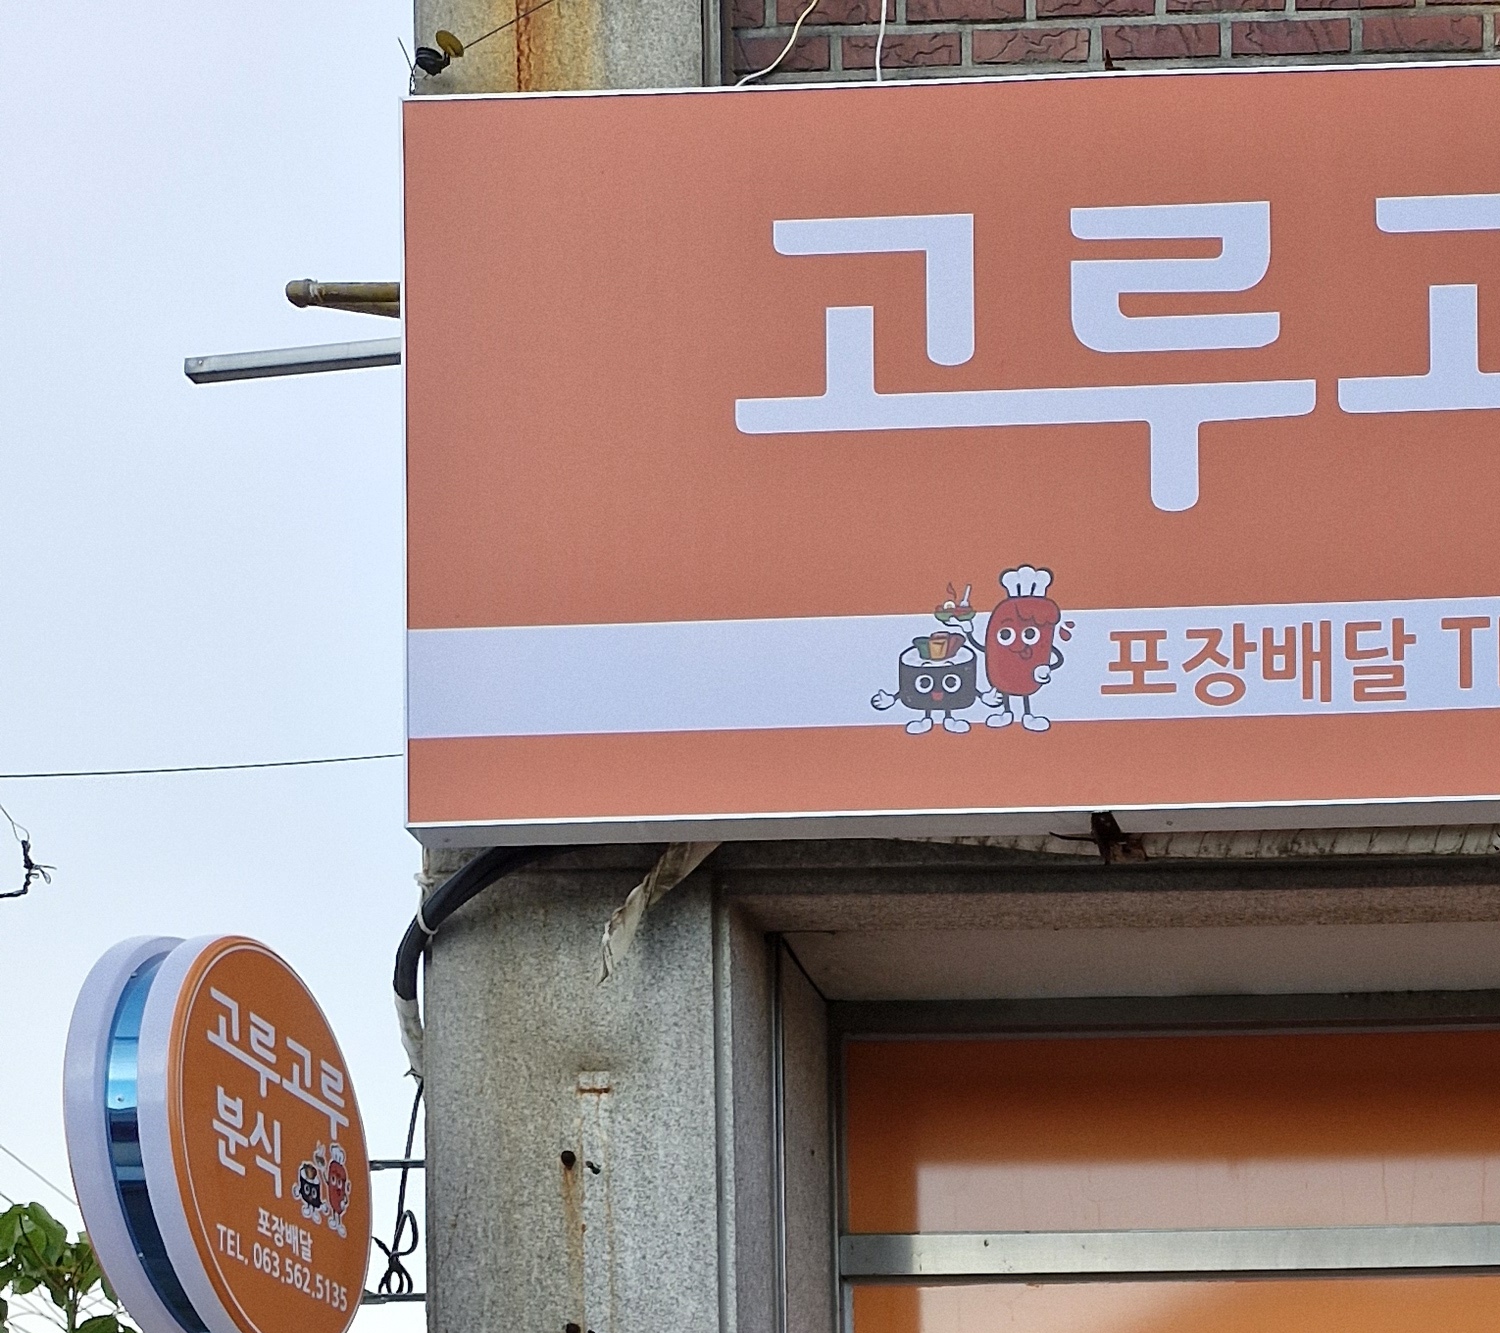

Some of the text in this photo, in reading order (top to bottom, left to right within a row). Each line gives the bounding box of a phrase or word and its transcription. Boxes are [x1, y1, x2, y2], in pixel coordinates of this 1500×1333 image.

[1101, 615, 1416, 708] 포장배달
[207, 986, 350, 1141] 고루고루
[212, 1084, 283, 1199] 분식
[216, 1223, 348, 1312] TEL. 063.562.5135
[257, 1207, 313, 1263] 포장배달
